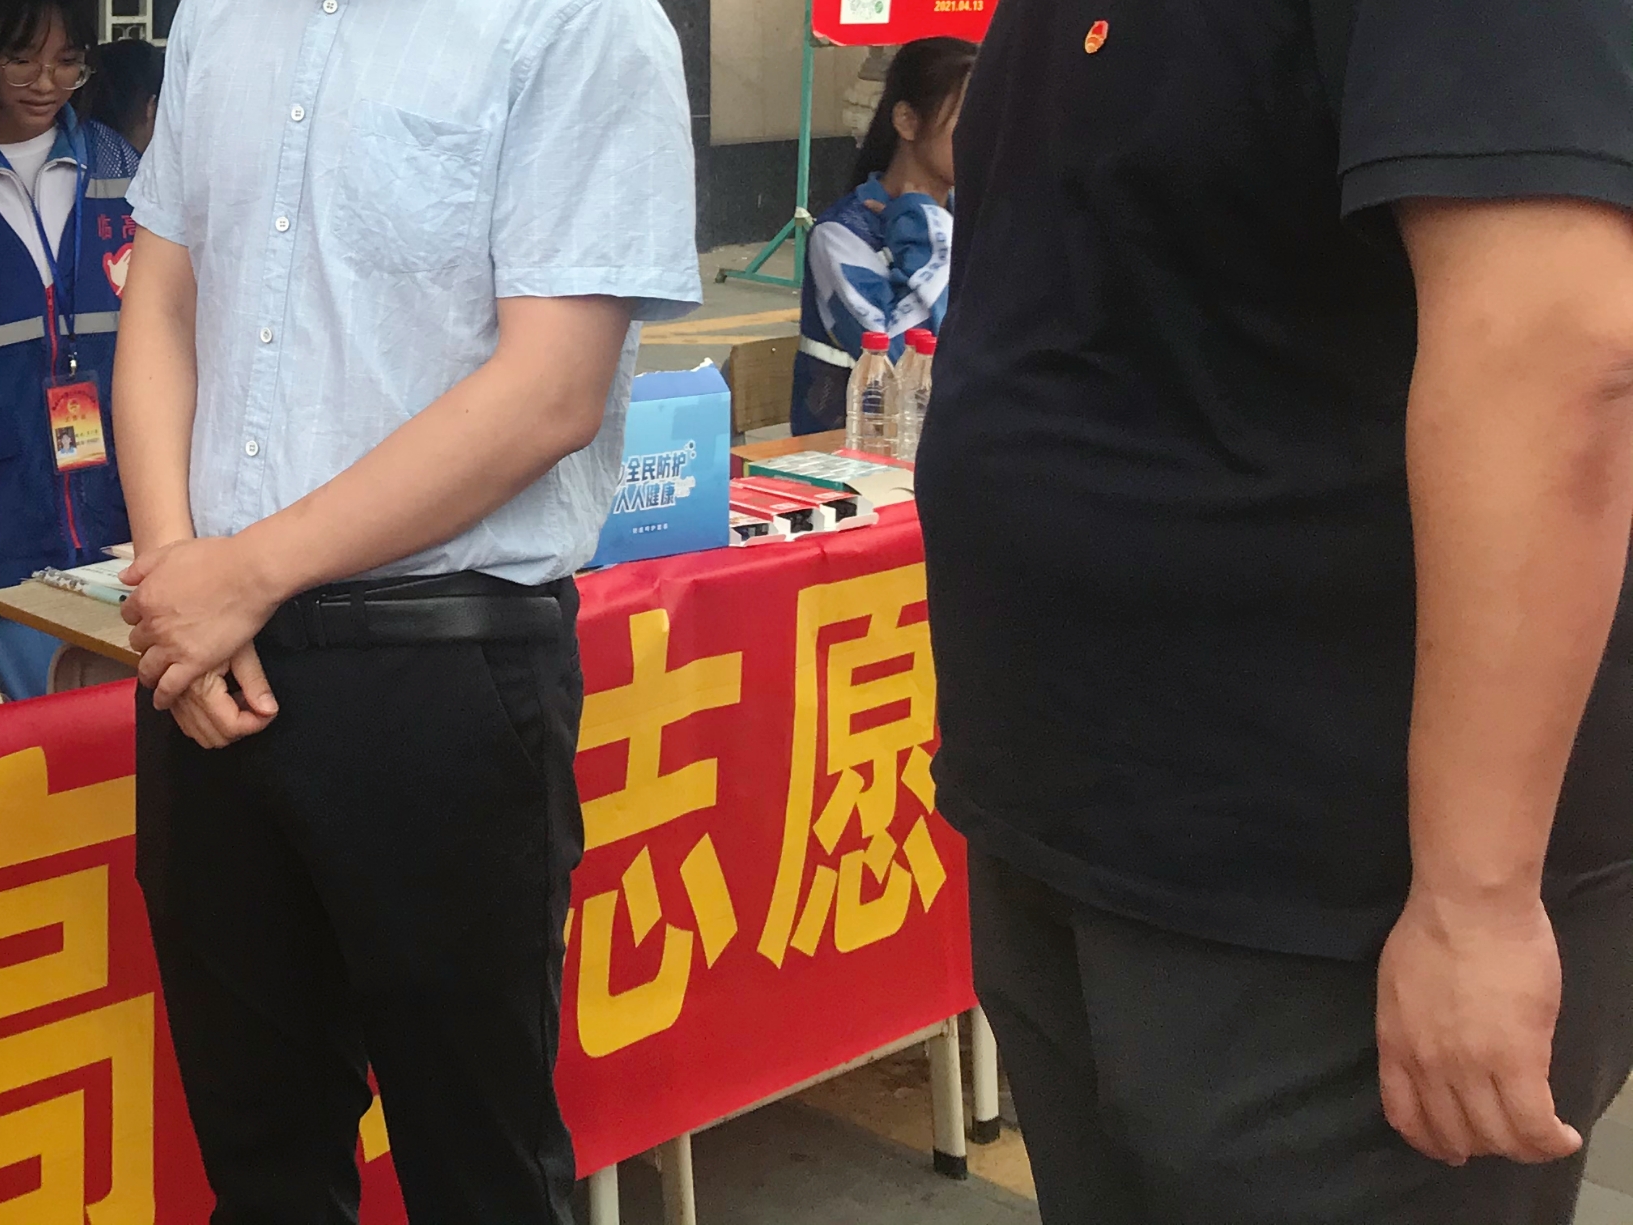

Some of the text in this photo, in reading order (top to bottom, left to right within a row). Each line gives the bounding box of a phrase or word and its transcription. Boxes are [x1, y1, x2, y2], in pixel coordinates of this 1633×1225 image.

[934, 0, 984, 12] 2021.04.13
[626, 451, 687, 483] 全民防护
[615, 482, 675, 513] 人人健康
